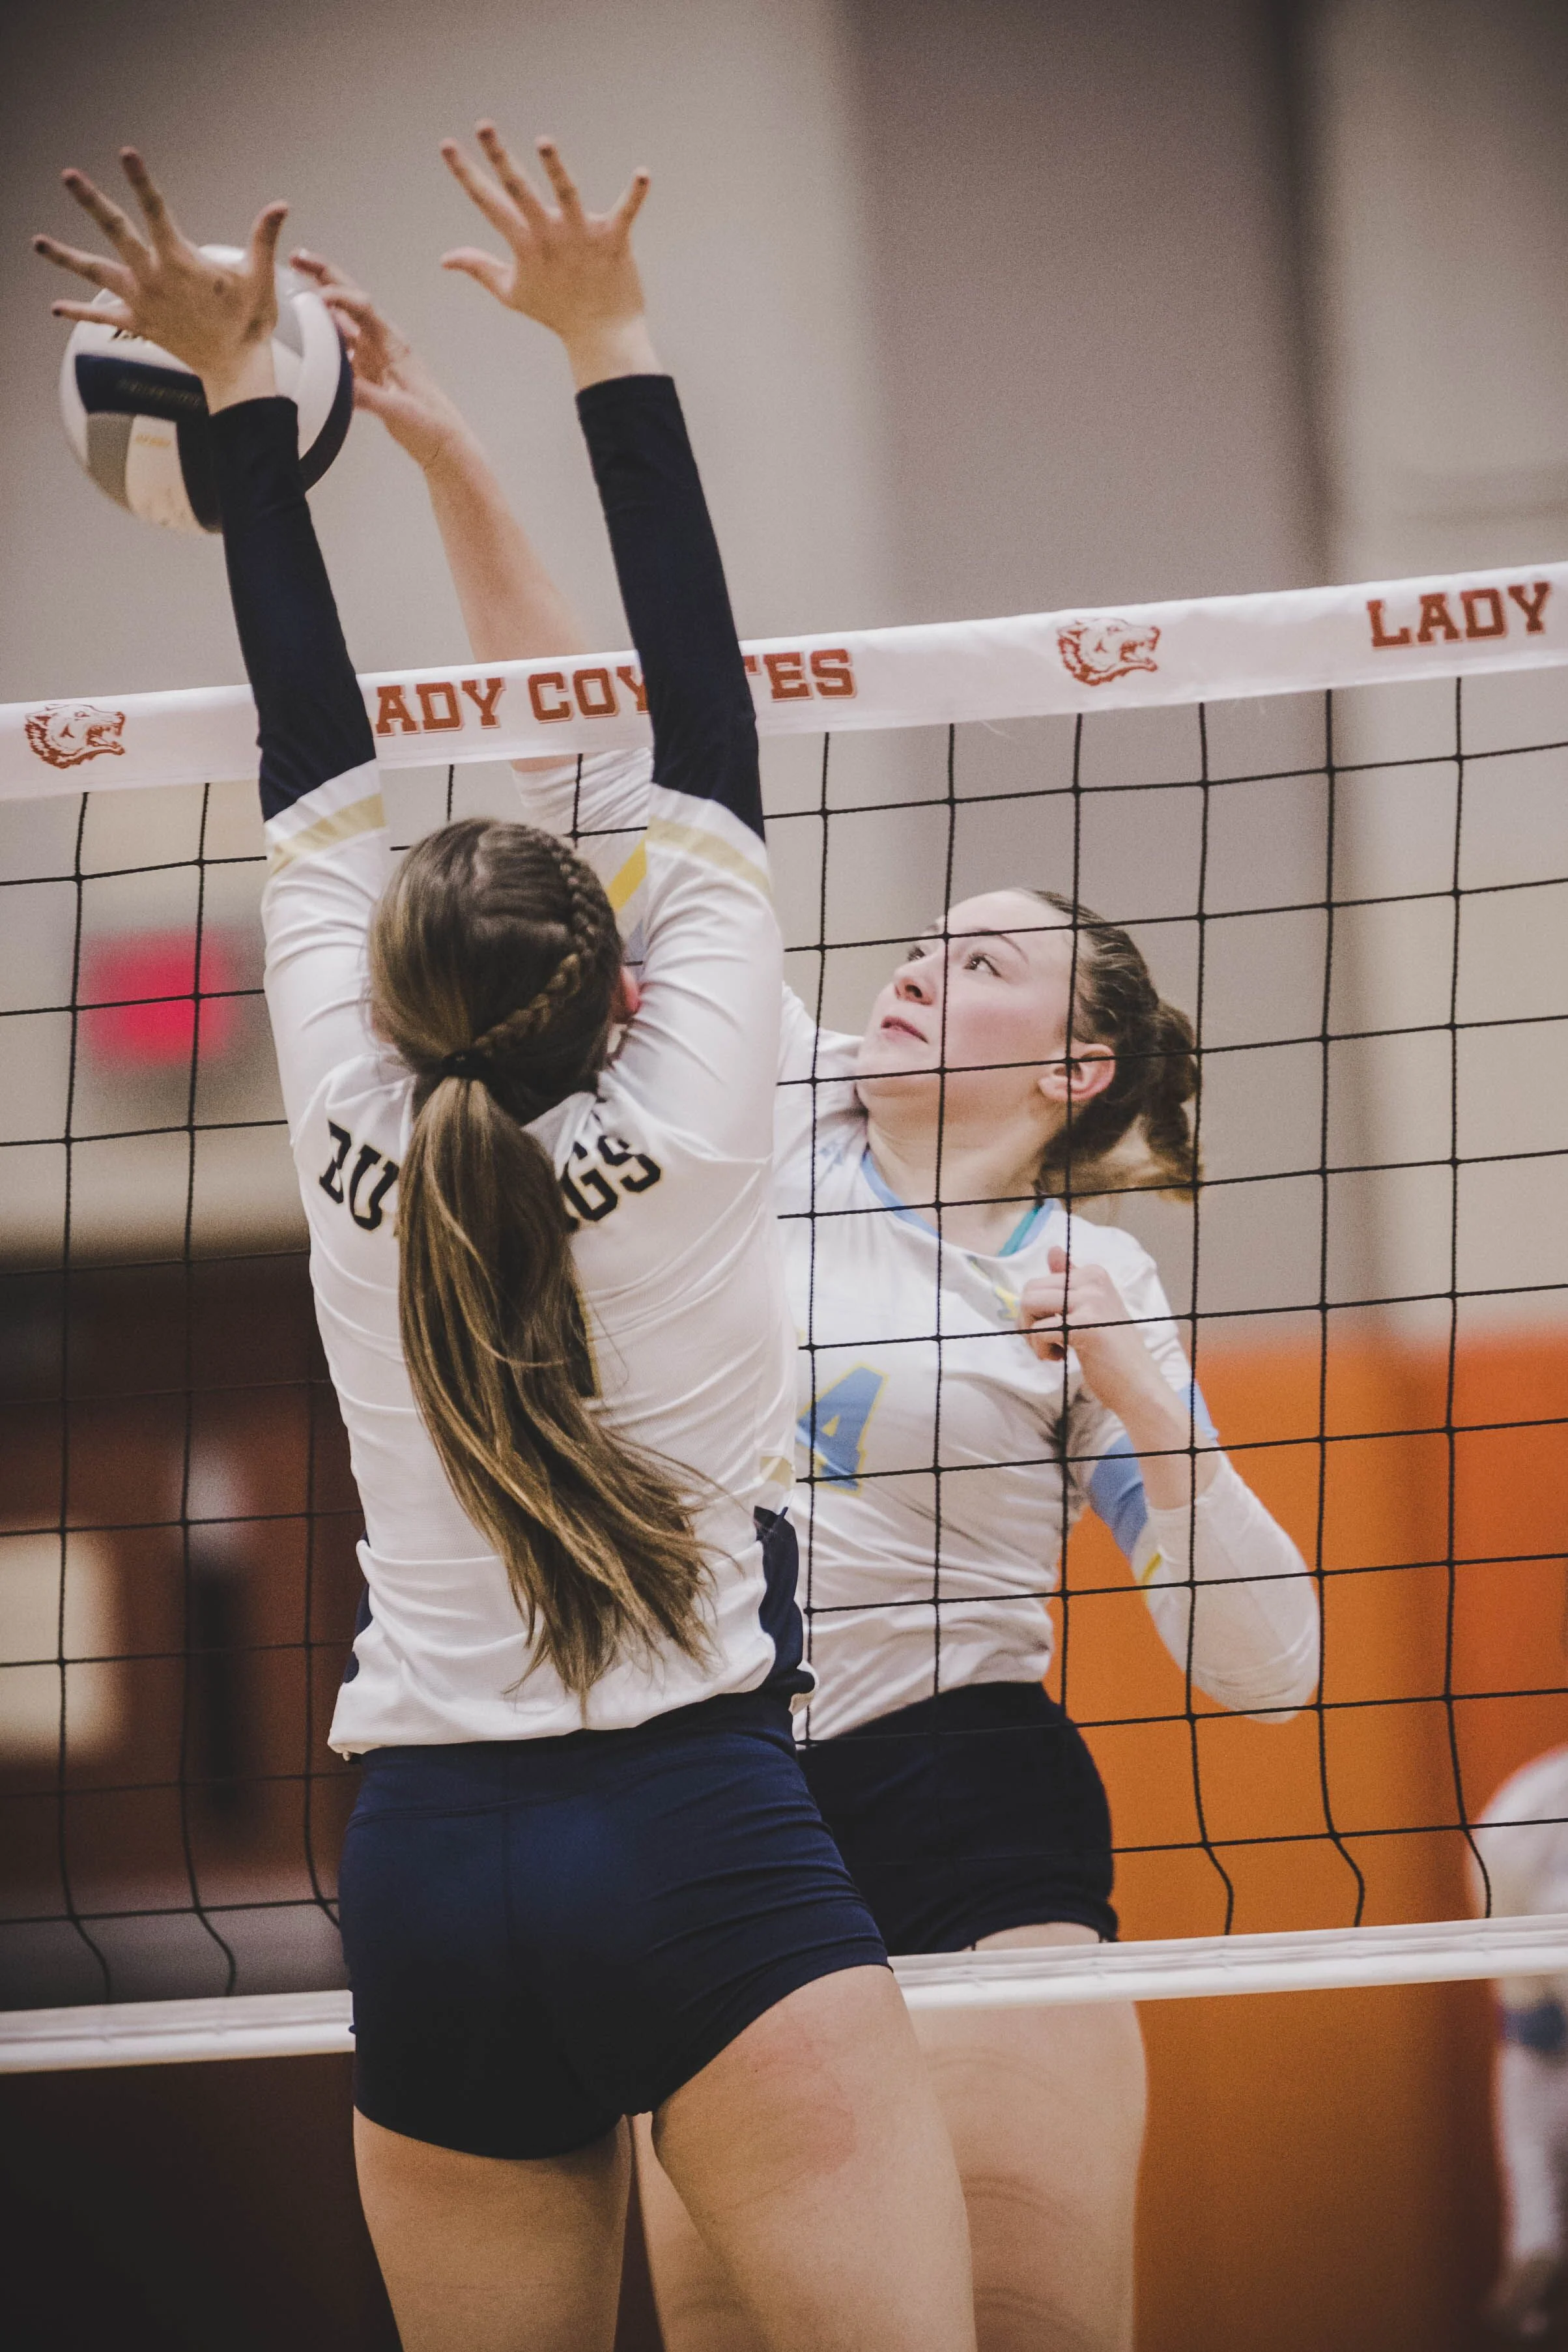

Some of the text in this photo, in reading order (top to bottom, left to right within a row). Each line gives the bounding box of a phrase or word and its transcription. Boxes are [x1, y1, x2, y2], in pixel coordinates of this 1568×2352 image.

[1365, 581, 1551, 649] LADY
[371, 648, 857, 737] ADY COYES
